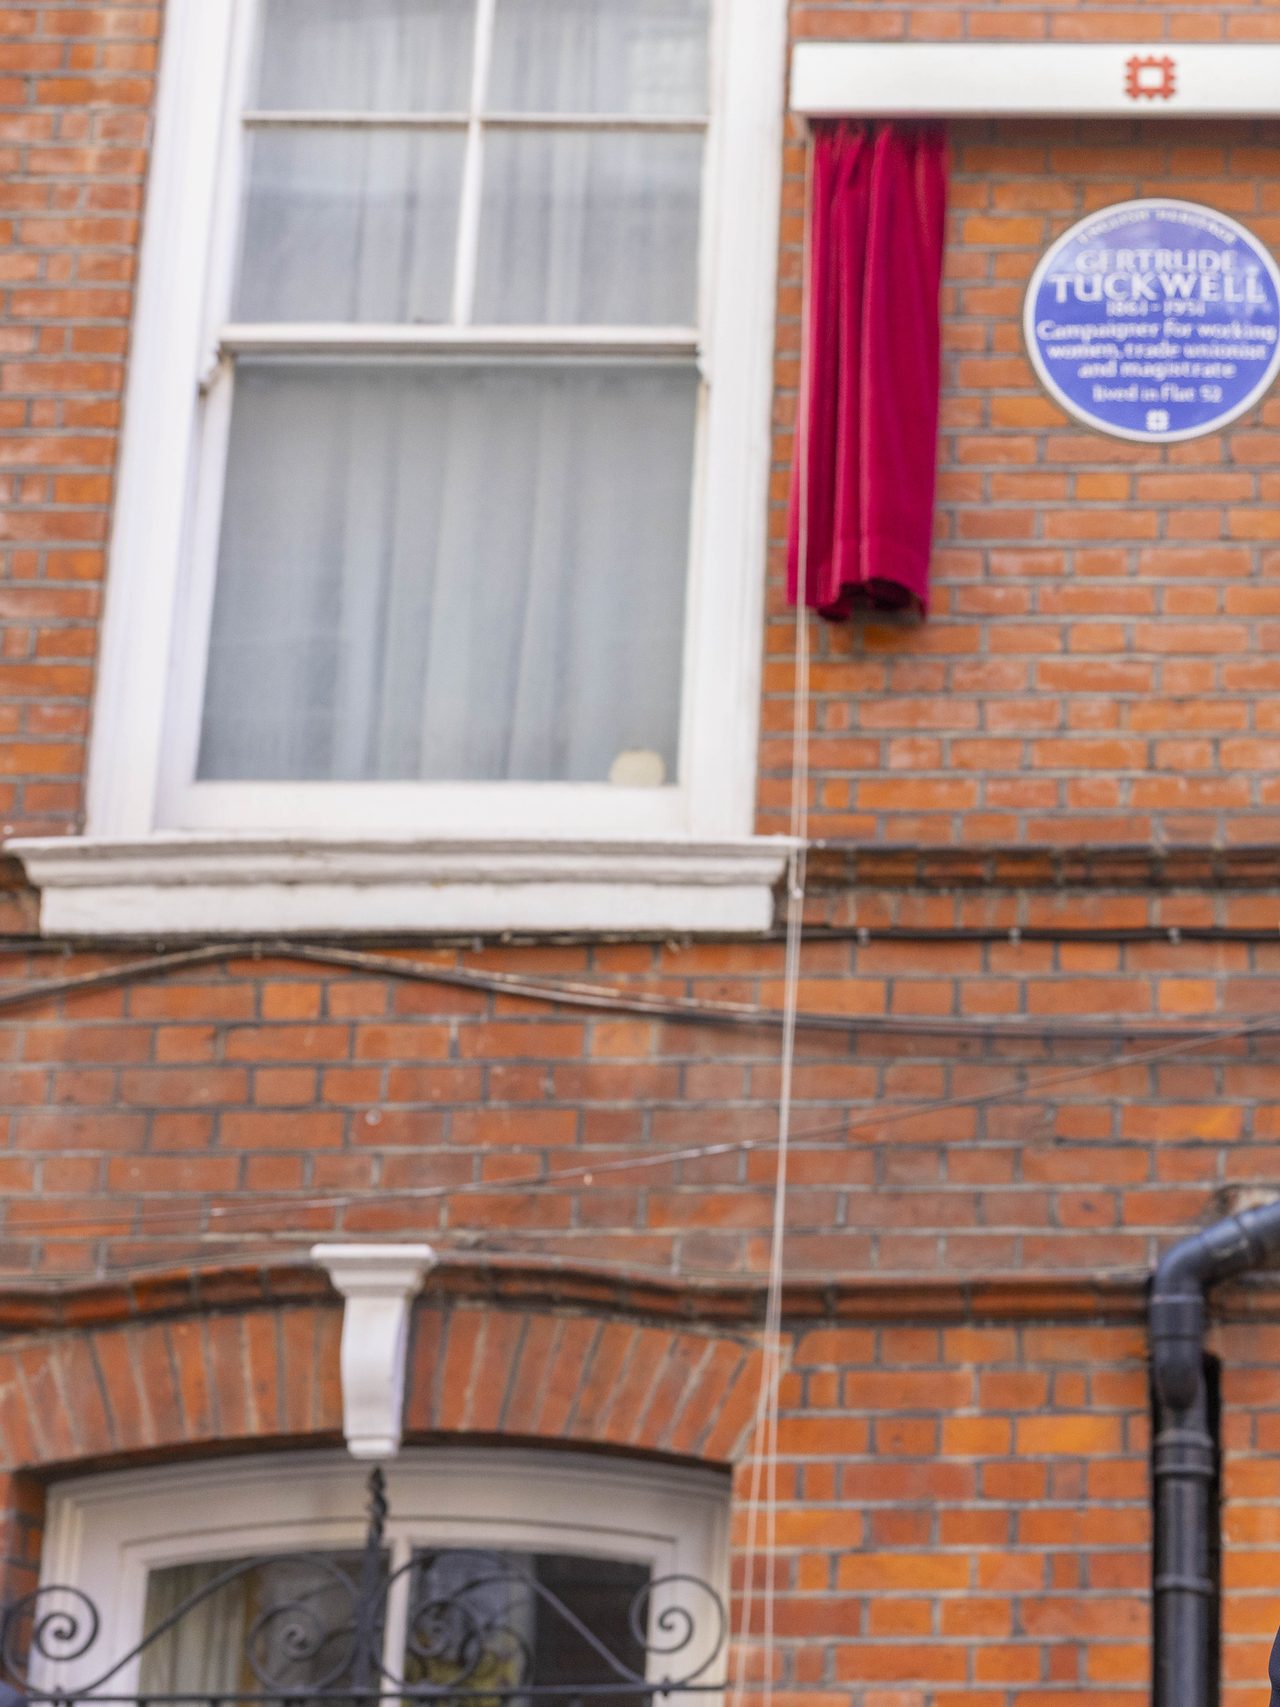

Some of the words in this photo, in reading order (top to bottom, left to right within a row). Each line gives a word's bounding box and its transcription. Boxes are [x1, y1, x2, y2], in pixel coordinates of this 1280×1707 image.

[1075, 248, 1238, 273] GERTRUDE
[1050, 272, 1267, 303] TUCKWELL
[1037, 319, 1160, 343] Campaigner
[1163, 319, 1192, 337] for
[1196, 320, 1277, 343] working
[1046, 343, 1120, 361] women,
[1123, 340, 1180, 360] trade
[1183, 342, 1267, 360] unionist
[1077, 360, 1117, 378] and
[1120, 360, 1237, 381] magistrate
[1092, 384, 1139, 403] lived
[1141, 386, 1158, 403] in
[1159, 384, 1196, 403] Flat
